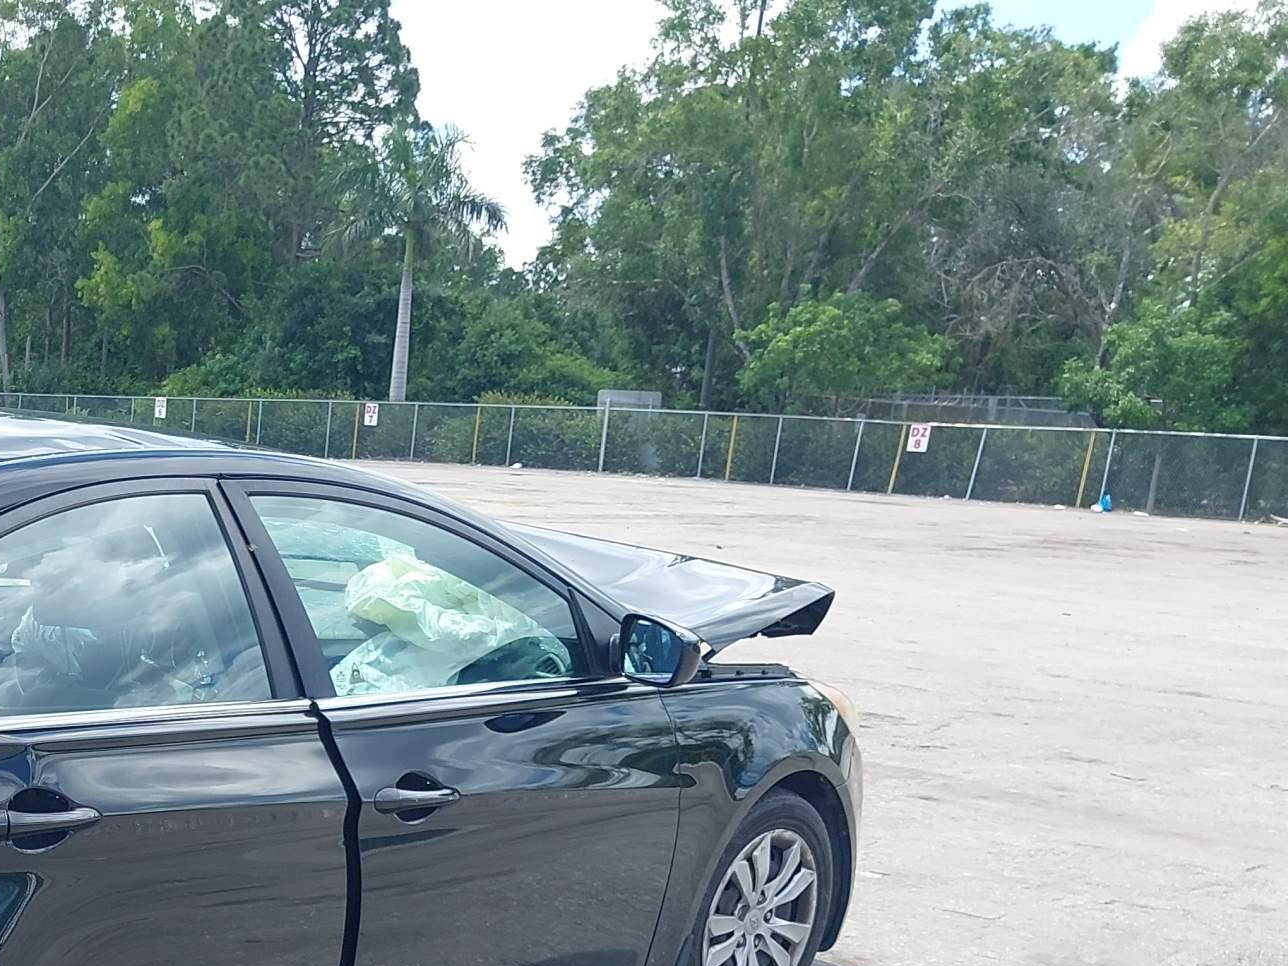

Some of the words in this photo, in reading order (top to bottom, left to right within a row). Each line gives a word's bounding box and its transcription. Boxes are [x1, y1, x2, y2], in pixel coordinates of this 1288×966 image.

[366, 405, 377, 414] DZ
[368, 415, 374, 424] 7
[911, 427, 928, 438] DZ
[914, 439, 921, 449] 8
